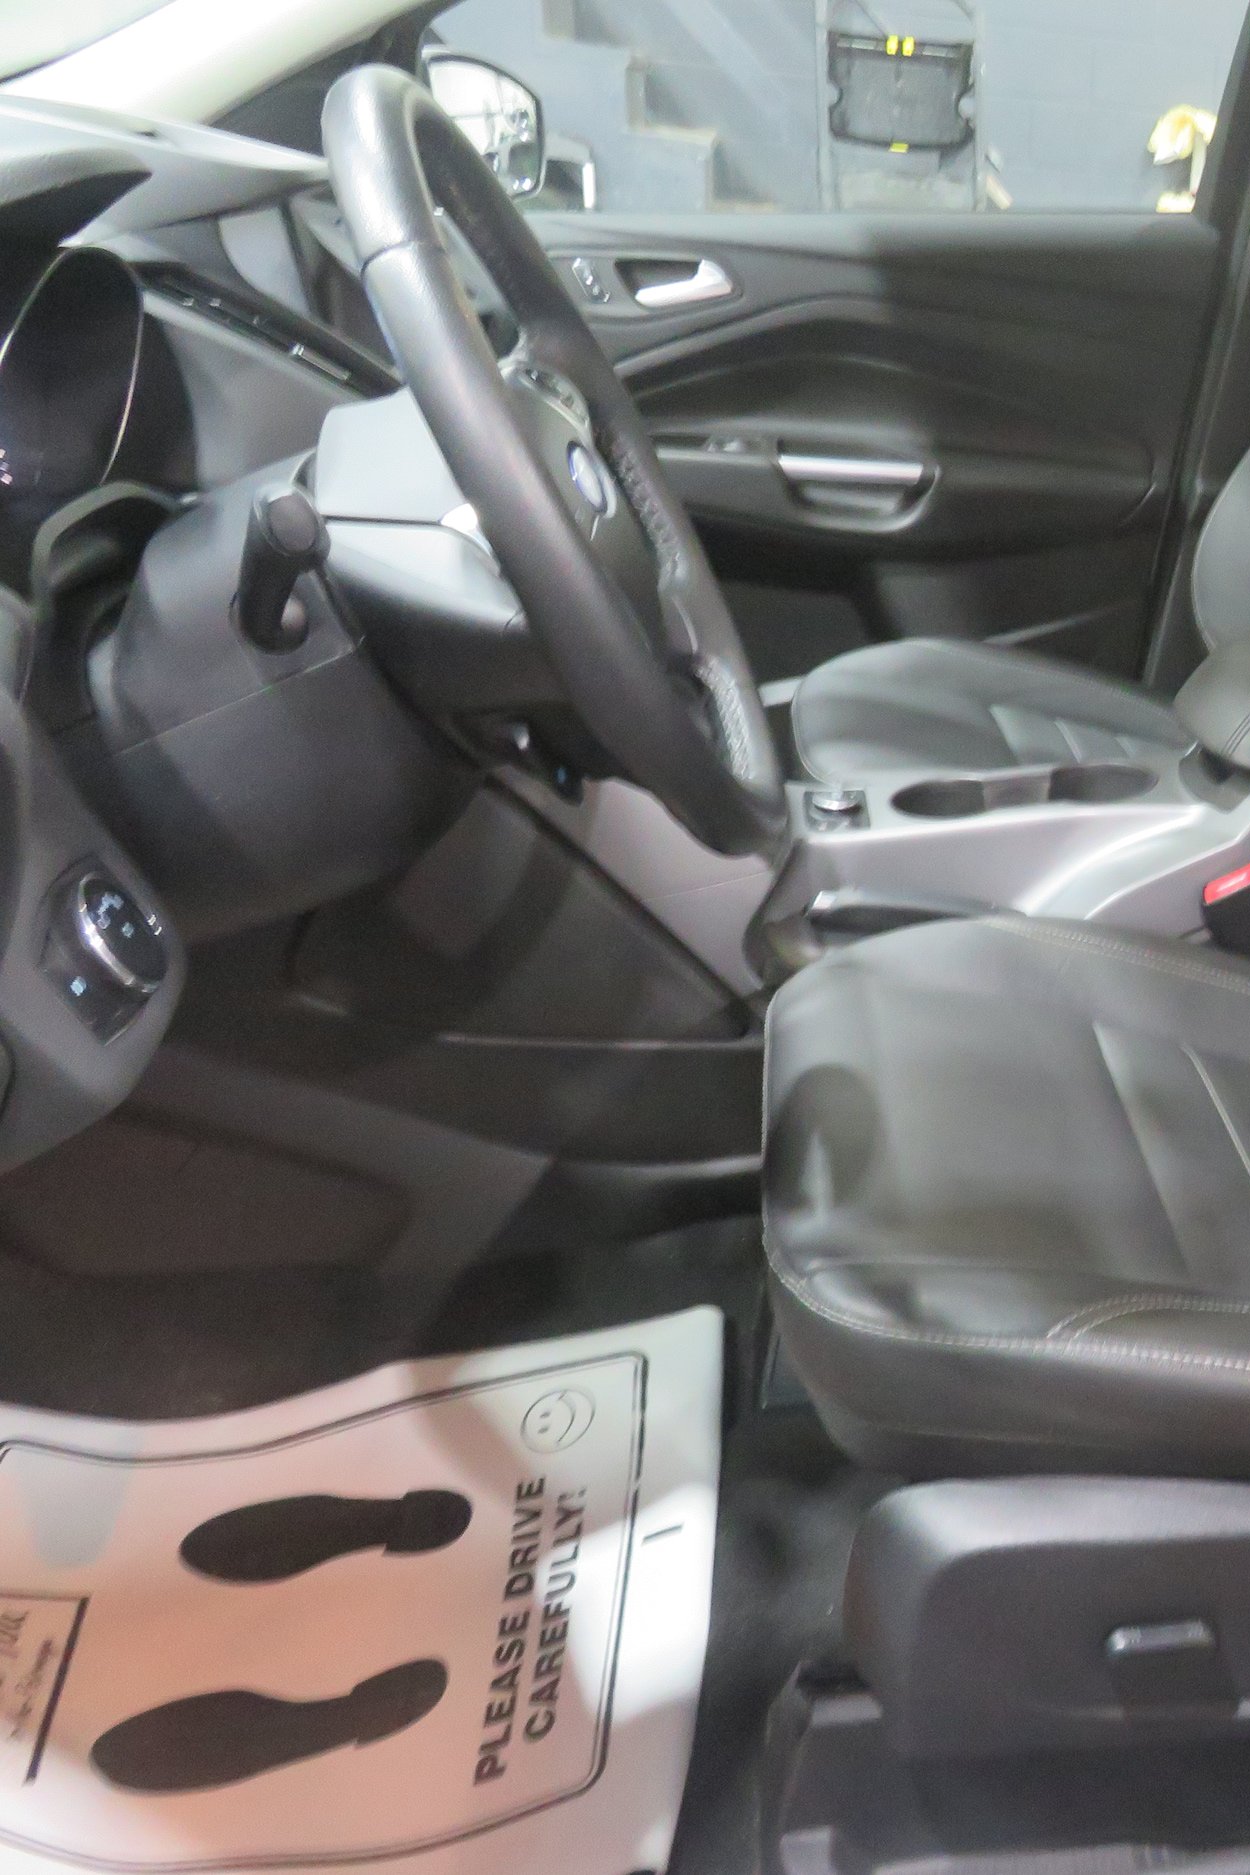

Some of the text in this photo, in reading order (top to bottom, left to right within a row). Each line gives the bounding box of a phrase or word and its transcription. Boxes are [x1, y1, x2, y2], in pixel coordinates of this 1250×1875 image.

[473, 1477, 546, 1786] PLEASE DRIVE
[523, 1486, 587, 1743] CAREFULLY!
